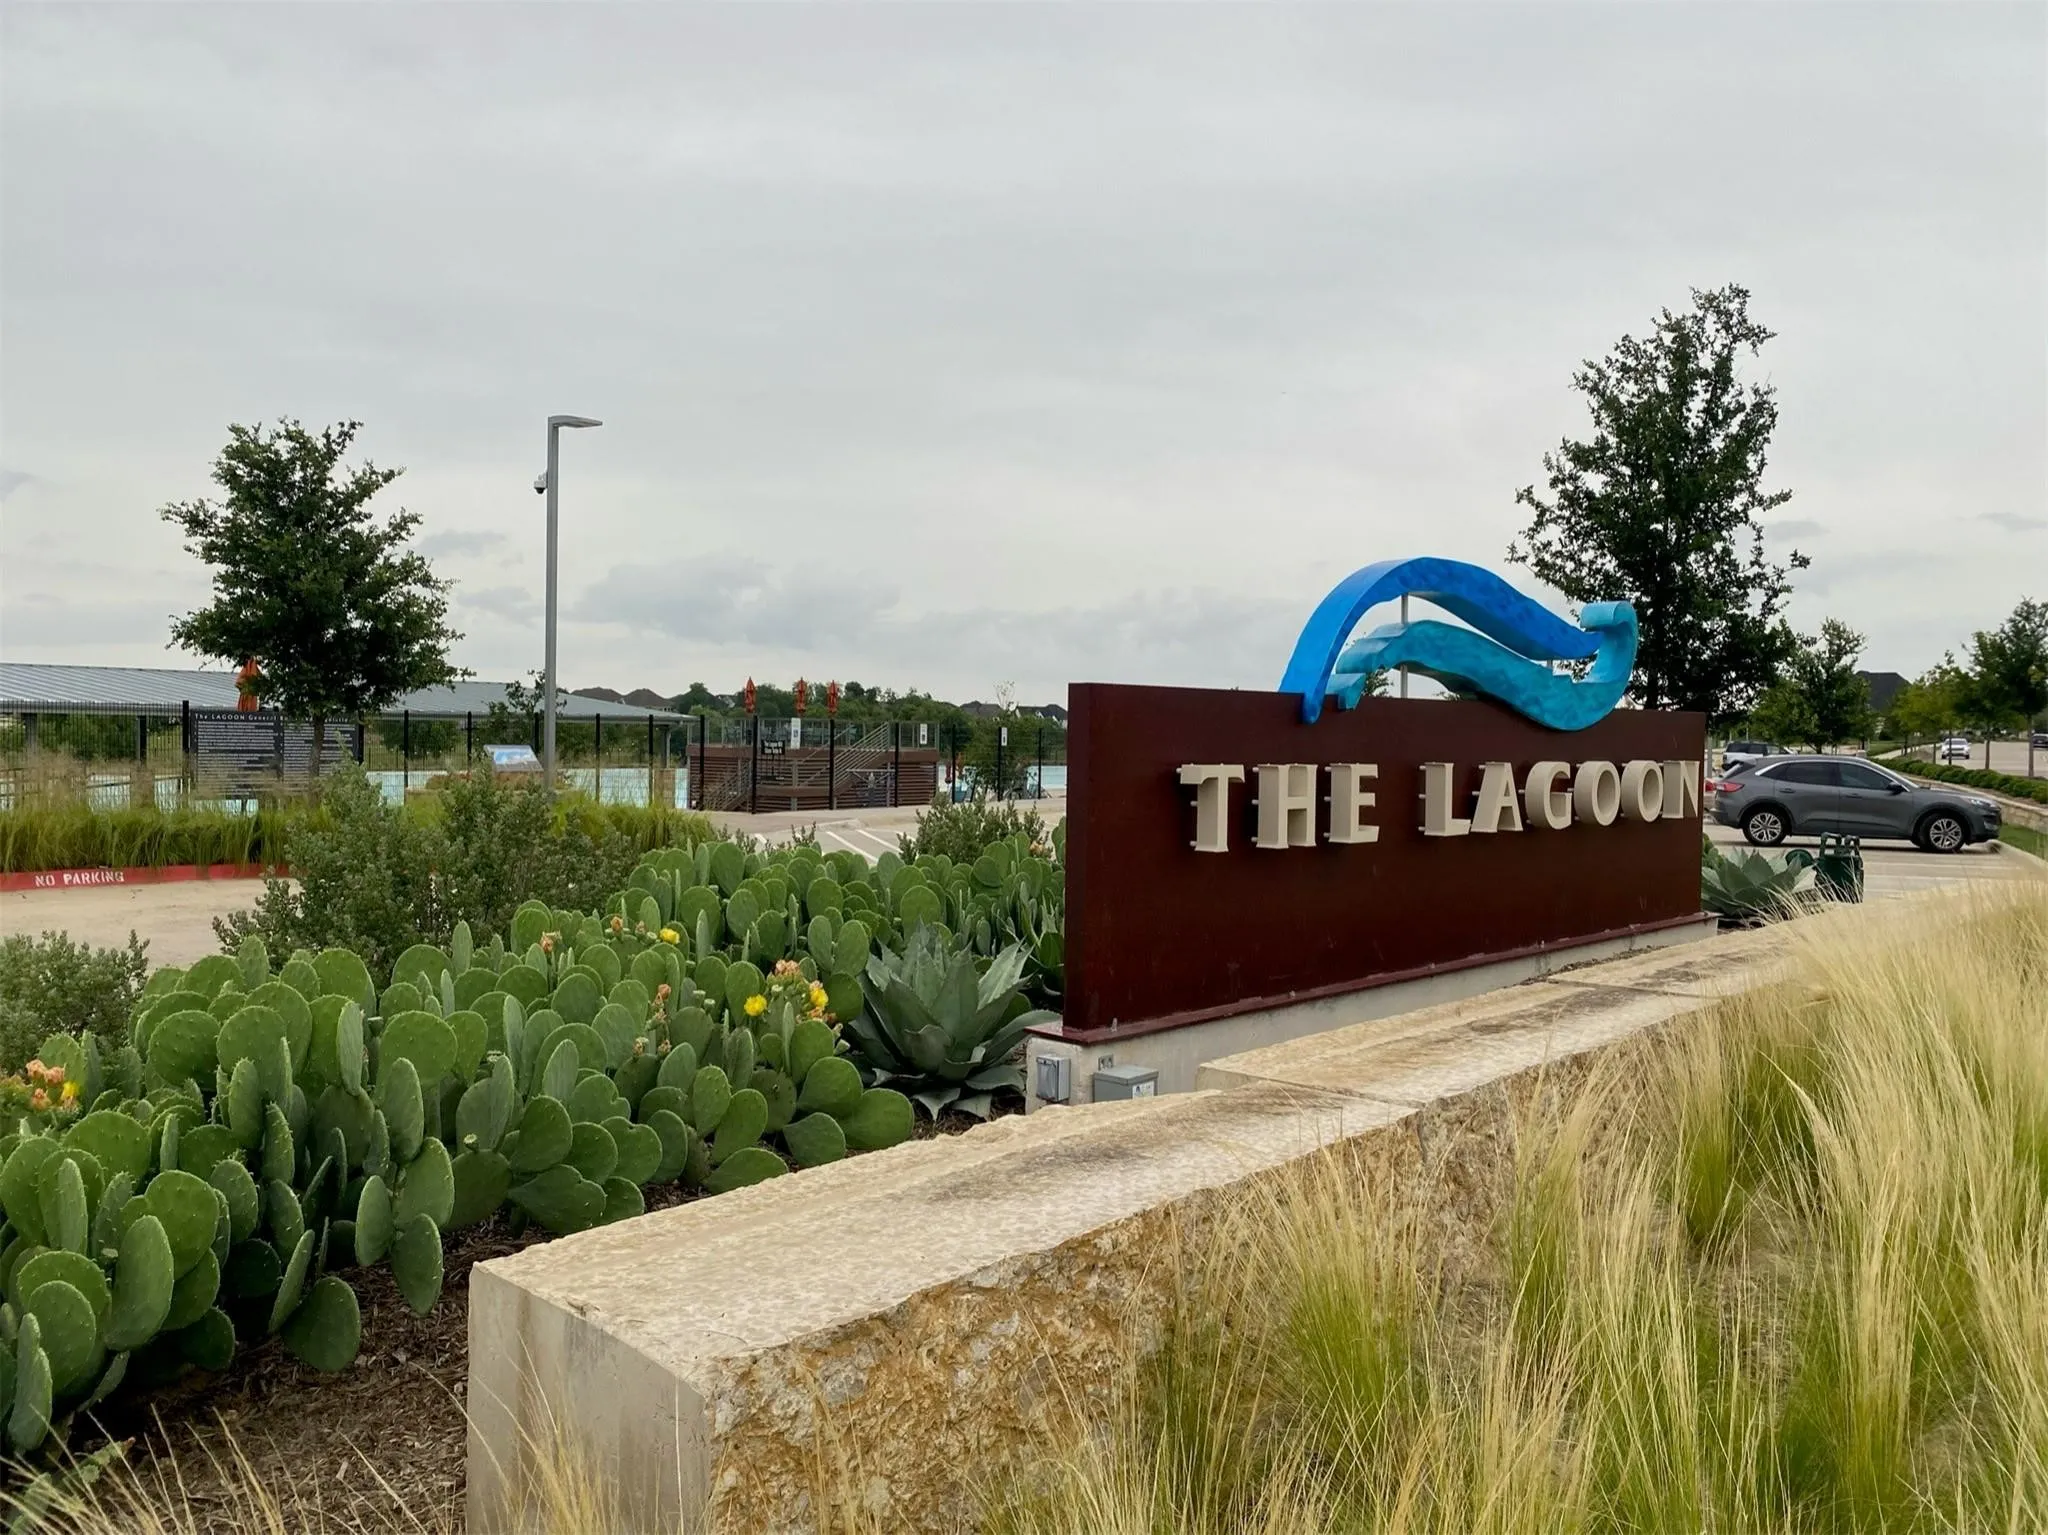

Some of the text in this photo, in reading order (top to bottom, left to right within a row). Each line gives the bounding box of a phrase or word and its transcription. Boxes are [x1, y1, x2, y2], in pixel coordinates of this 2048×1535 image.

[1178, 760, 1700, 853] THE LAGOON
[34, 871, 125, 887] NO PARKING
